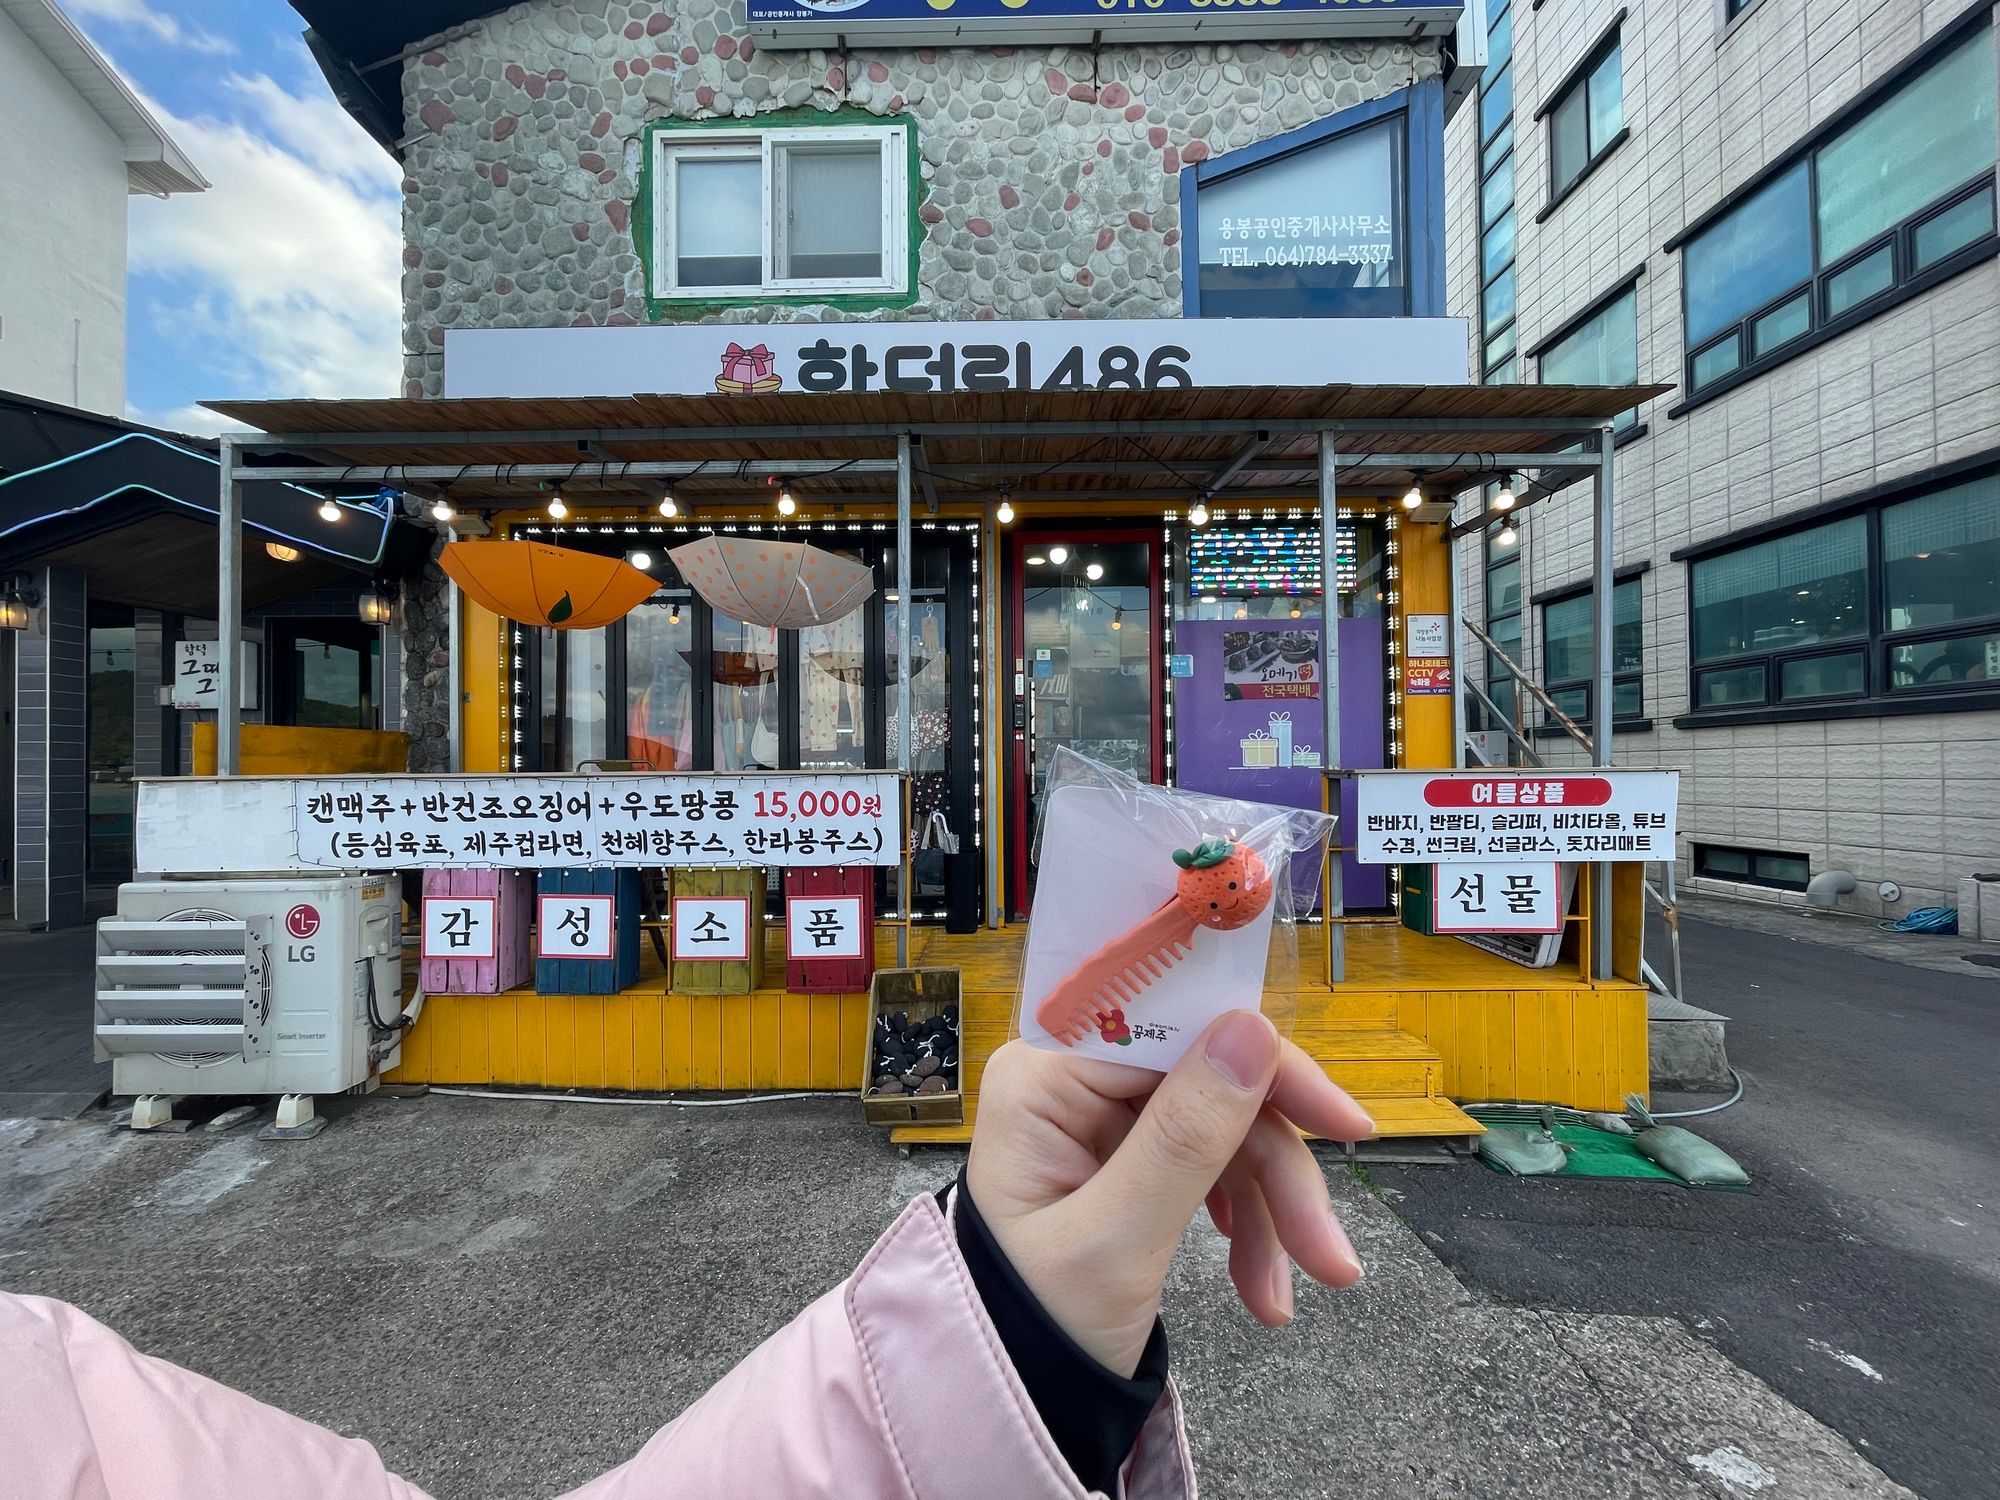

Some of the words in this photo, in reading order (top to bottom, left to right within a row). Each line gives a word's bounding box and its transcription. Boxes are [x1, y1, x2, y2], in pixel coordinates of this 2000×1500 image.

[1218, 215, 1391, 240] 용봉공인중개사사무소
[1265, 244, 1393, 267] 064)784-3337
[184, 643, 207, 656] 함덕
[1408, 659, 1451, 668] 하나로테크
[1408, 669, 1434, 677] CCTV
[195, 678, 219, 694] 그
[1262, 684, 1311, 697] 전국택배
[1410, 678, 1431, 687] 녹화중
[1471, 782, 1565, 804] 여름상품
[753, 790, 883, 823] 15,000원
[1367, 815, 1424, 833] 반바지,
[1429, 814, 1485, 833] 반팔티,
[1491, 813, 1547, 832] 슬리퍼,
[1552, 813, 1626, 831] 비치타올,
[1632, 812, 1666, 829] 튜브
[331, 830, 455, 860] (등심육포,
[462, 829, 592, 859] 제주컵라면,
[600, 828, 735, 859] 천혜향주스,
[744, 827, 883, 857] 한라봉주스)
[1382, 837, 1421, 855] 수경,
[1426, 836, 1482, 855] 썬크림,
[1488, 836, 1561, 855] 선글라스,
[1566, 835, 1652, 852] 돗자리매트
[440, 907, 479, 948] 감
[556, 906, 591, 947] 성
[690, 911, 730, 943] 소
[804, 907, 846, 948] 품
[288, 945, 316, 963] LG
[299, 1032, 327, 1040] Inverter
